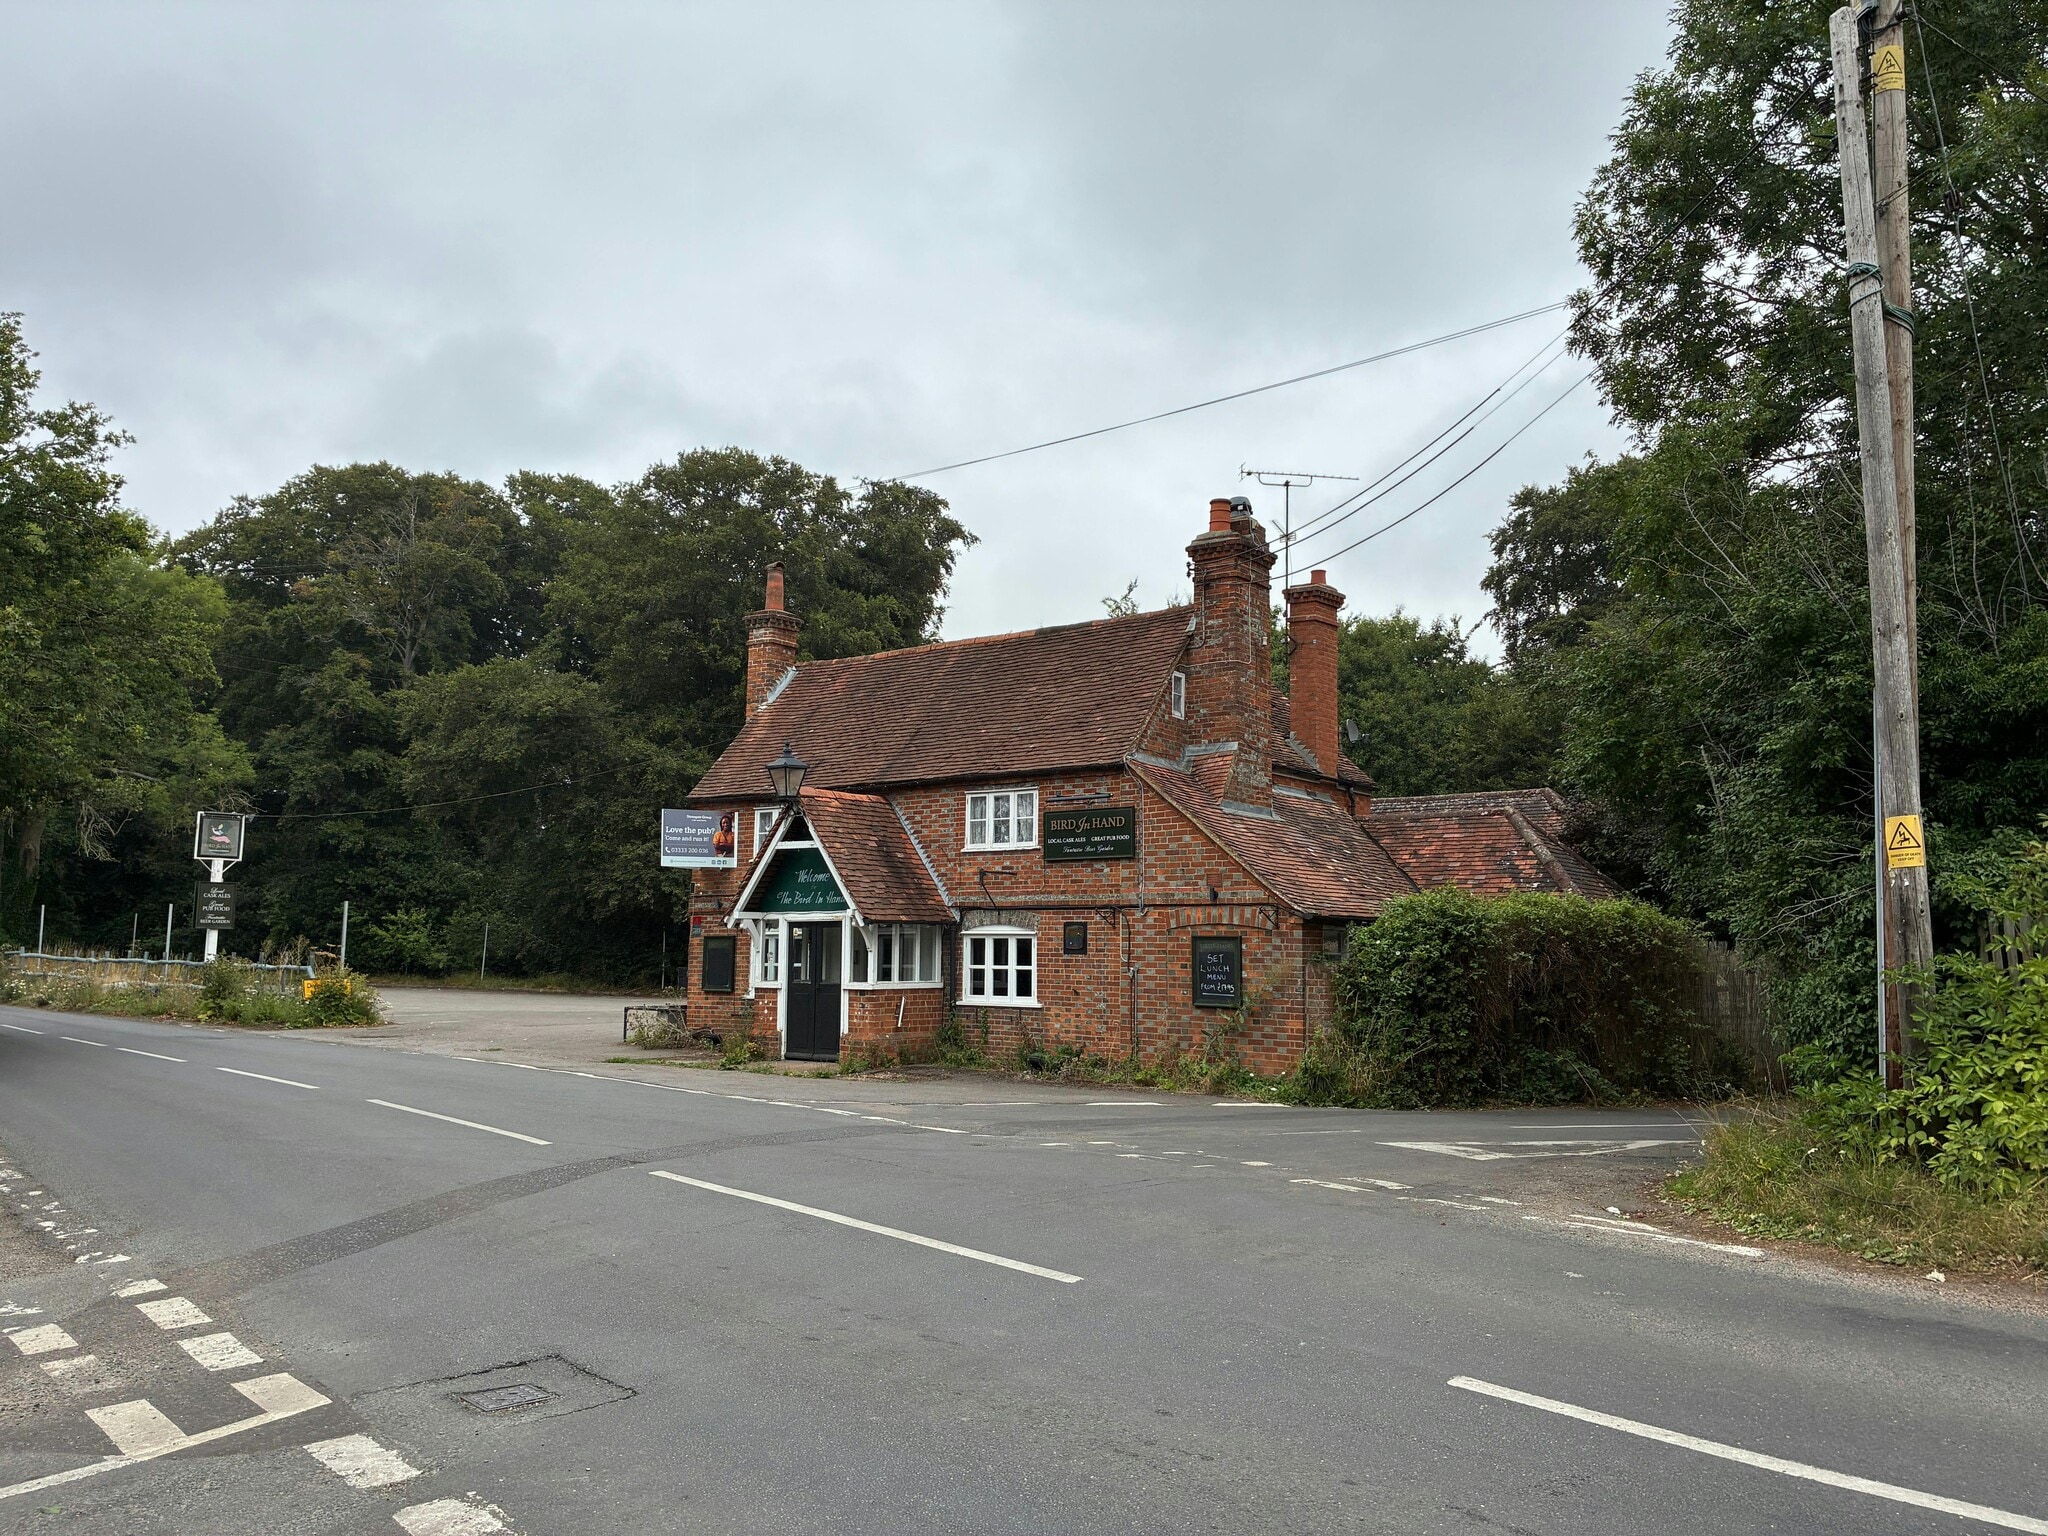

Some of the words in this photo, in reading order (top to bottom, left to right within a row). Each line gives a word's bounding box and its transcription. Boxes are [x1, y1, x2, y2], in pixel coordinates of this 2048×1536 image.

[1051, 819, 1076, 831] BIRD
[1075, 815, 1090, 833] In
[1092, 816, 1125, 828] HAND
[665, 825, 683, 834] Love
[684, 826, 697, 834] the
[697, 827, 716, 836] pub?
[1097, 844, 1114, 853] Garden
[795, 868, 831, 884] Welcome
[776, 891, 793, 905] The
[793, 890, 815, 905] Bird
[815, 891, 824, 904] In
[1207, 953, 1224, 964] SET
[1200, 964, 1230, 973] LUNCH
[1206, 973, 1227, 981] MENU
[1200, 982, 1216, 991] FROM
